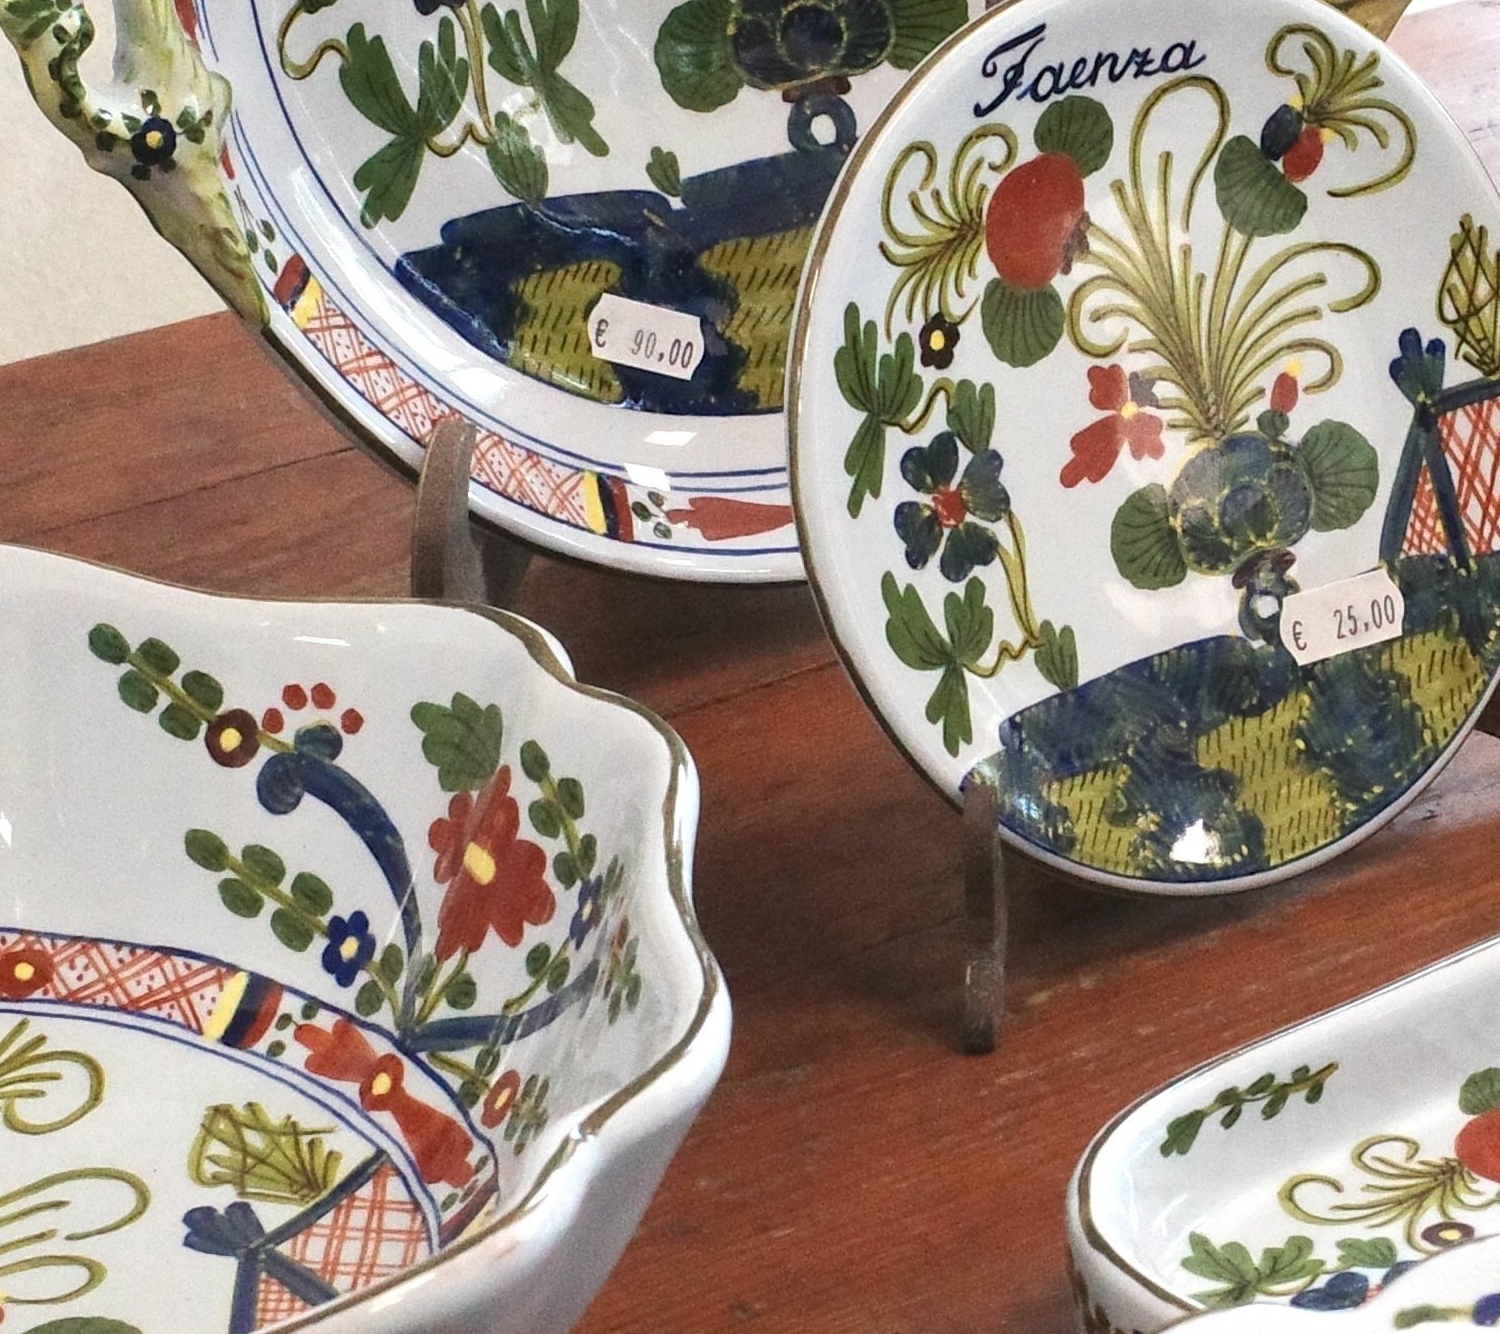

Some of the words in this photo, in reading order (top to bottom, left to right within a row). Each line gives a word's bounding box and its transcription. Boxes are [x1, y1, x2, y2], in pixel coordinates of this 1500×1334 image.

[973, 22, 1207, 118] Faenza
[594, 318, 609, 348] €
[630, 329, 694, 369] 90,00
[1291, 620, 1308, 652] €
[1333, 594, 1396, 640] 25,00
